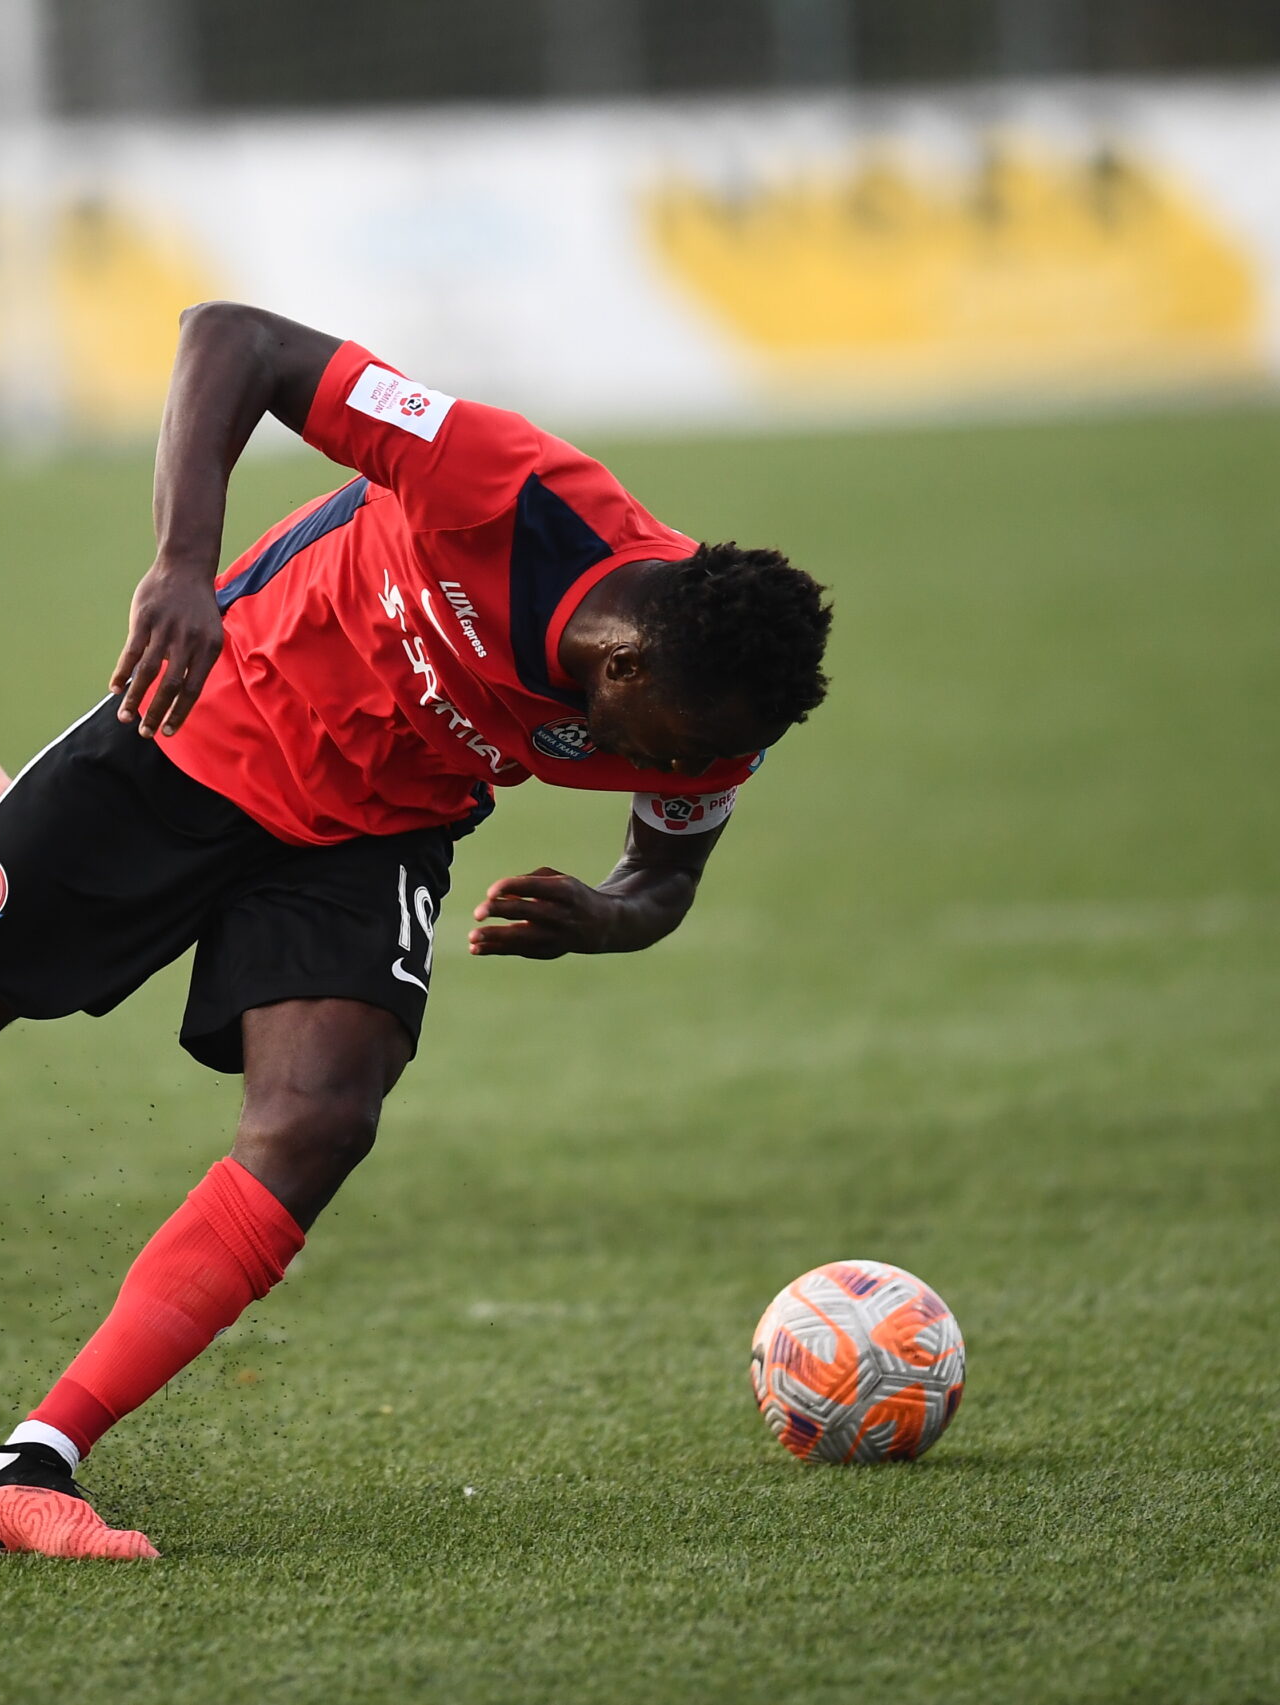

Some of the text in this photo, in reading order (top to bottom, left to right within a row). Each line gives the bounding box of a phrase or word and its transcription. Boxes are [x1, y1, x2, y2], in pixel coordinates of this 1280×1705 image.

[439, 581, 487, 658] LUX Express
[398, 864, 434, 975] 19
